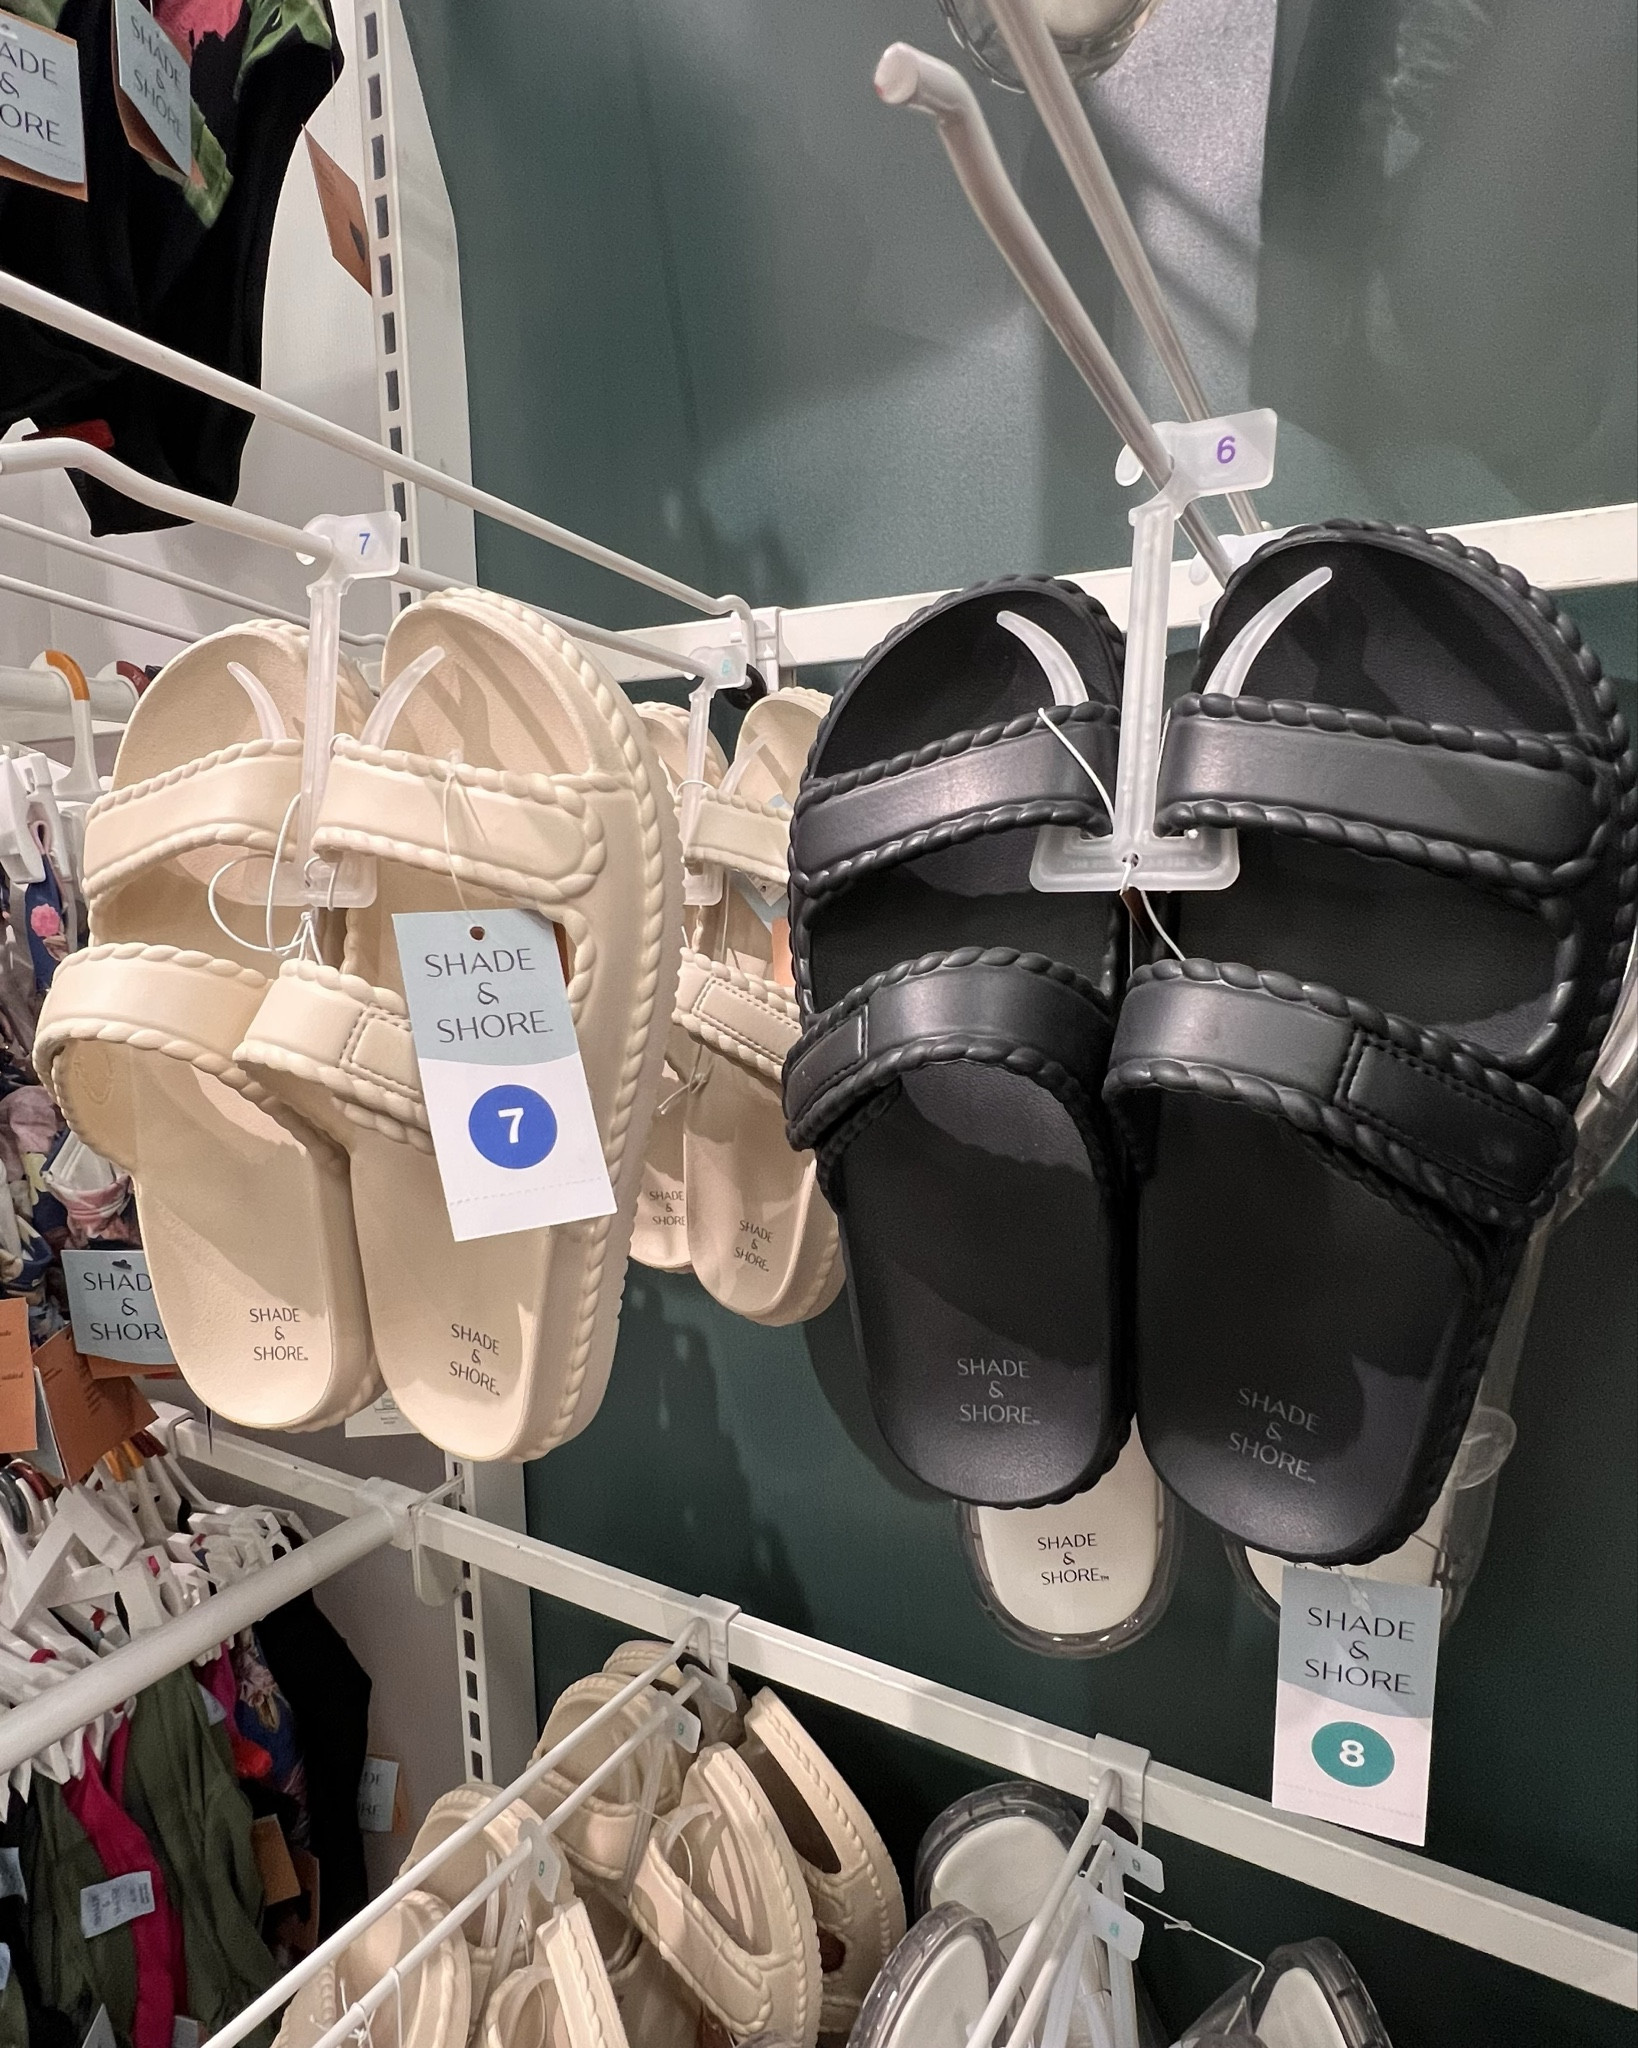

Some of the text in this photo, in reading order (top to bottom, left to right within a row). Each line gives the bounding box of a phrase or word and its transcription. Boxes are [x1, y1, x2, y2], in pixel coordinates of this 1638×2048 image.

[0, 42, 58, 85] ADE
[131, 15, 181, 92] SHADE
[134, 69, 184, 143] SHORE
[0, 104, 66, 147] ORE
[1217, 435, 1236, 464] 6
[359, 532, 371, 555] 7
[424, 948, 536, 978] SHADE
[477, 981, 499, 1005] &
[436, 1009, 553, 1043] SHORE
[497, 1107, 524, 1144] 7
[649, 1190, 685, 1201] SHADE
[665, 1203, 674, 1213] &
[652, 1215, 686, 1226] SHORE
[739, 1219, 774, 1243] SHADE
[751, 1238, 758, 1250] &
[83, 1271, 153, 1292] SHAD
[121, 1297, 138, 1316] &
[249, 1307, 301, 1323] SHADE
[90, 1322, 166, 1341] SHOR
[274, 1325, 285, 1341] &
[451, 1323, 500, 1356] SHADE
[471, 1348, 482, 1366] &
[956, 1357, 1031, 1379] SHADE
[988, 1380, 1004, 1399] &
[1237, 1387, 1321, 1436] SHADE
[1265, 1421, 1282, 1442] &
[1037, 1532, 1098, 1551] SHADE
[1062, 1551, 1076, 1566] &
[1307, 1606, 1416, 1643] SHADE
[1348, 1640, 1370, 1661] &
[1304, 1658, 1416, 1695] SHORE
[1339, 1739, 1366, 1768] 8
